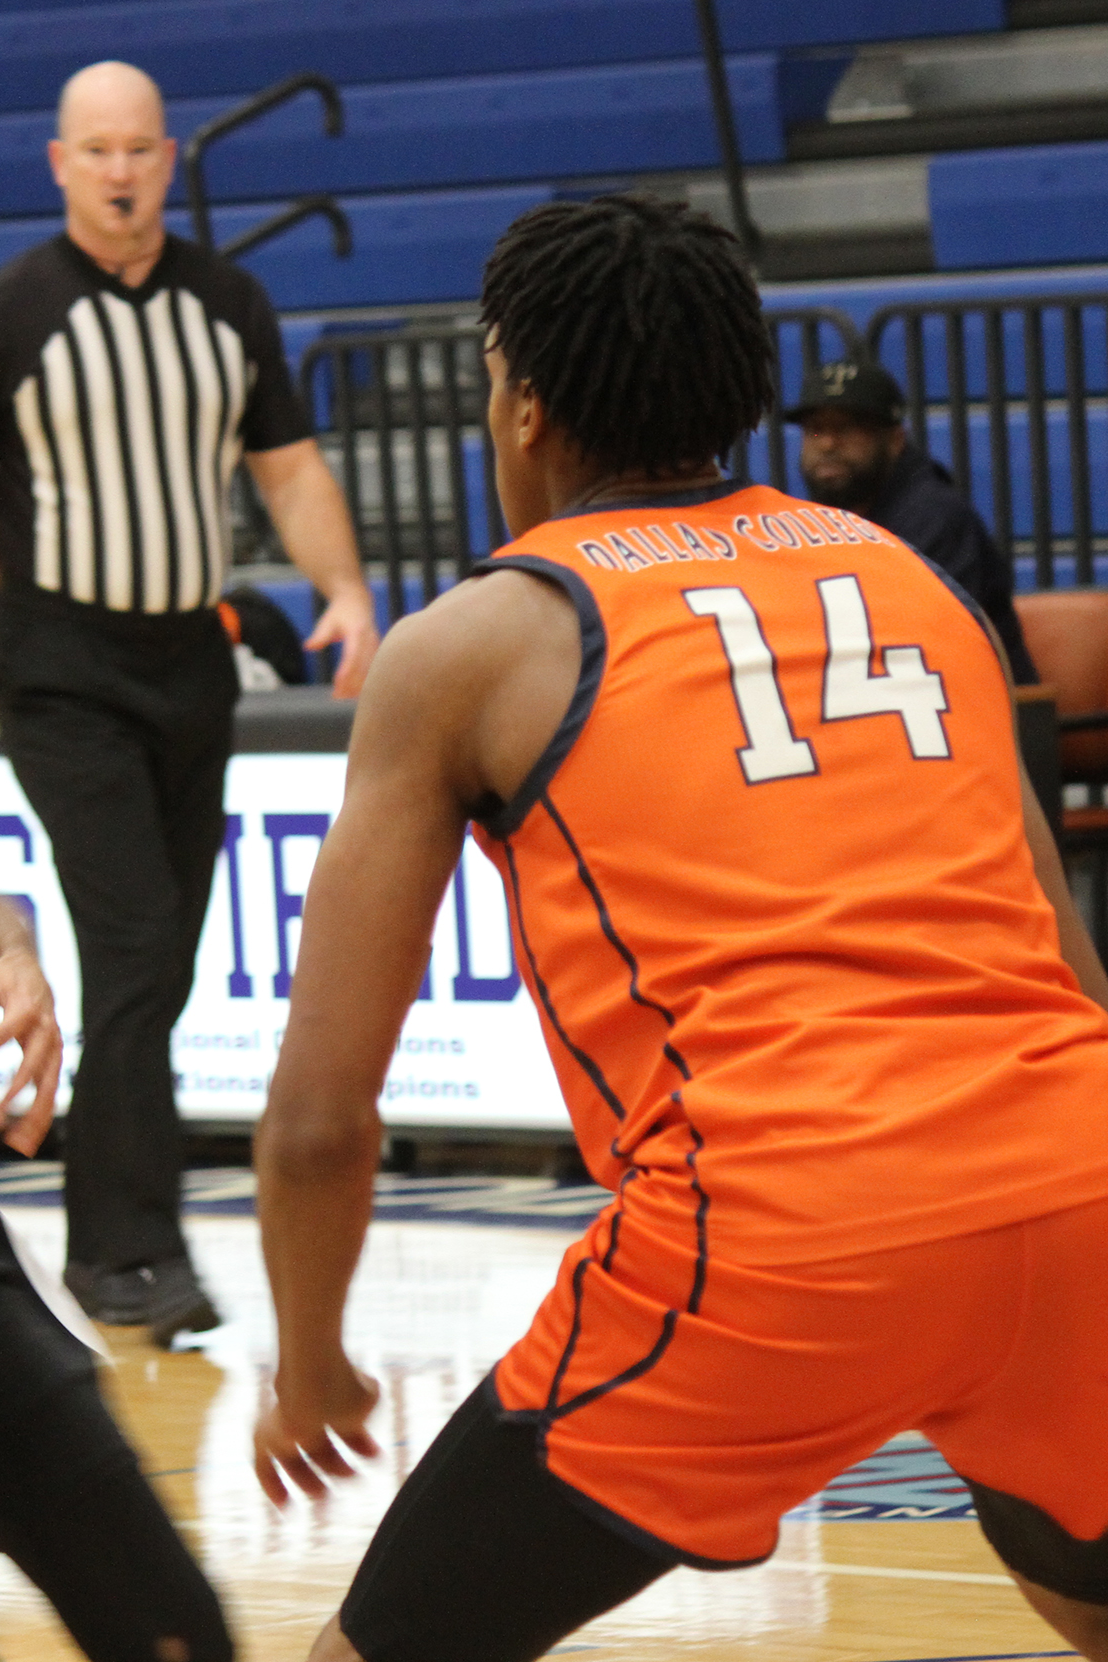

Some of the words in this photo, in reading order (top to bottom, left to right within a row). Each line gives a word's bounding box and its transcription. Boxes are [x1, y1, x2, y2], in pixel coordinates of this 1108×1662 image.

[577, 522, 737, 572] DALLAS
[733, 508, 896, 551] COLLEG
[681, 574, 953, 786] 14
